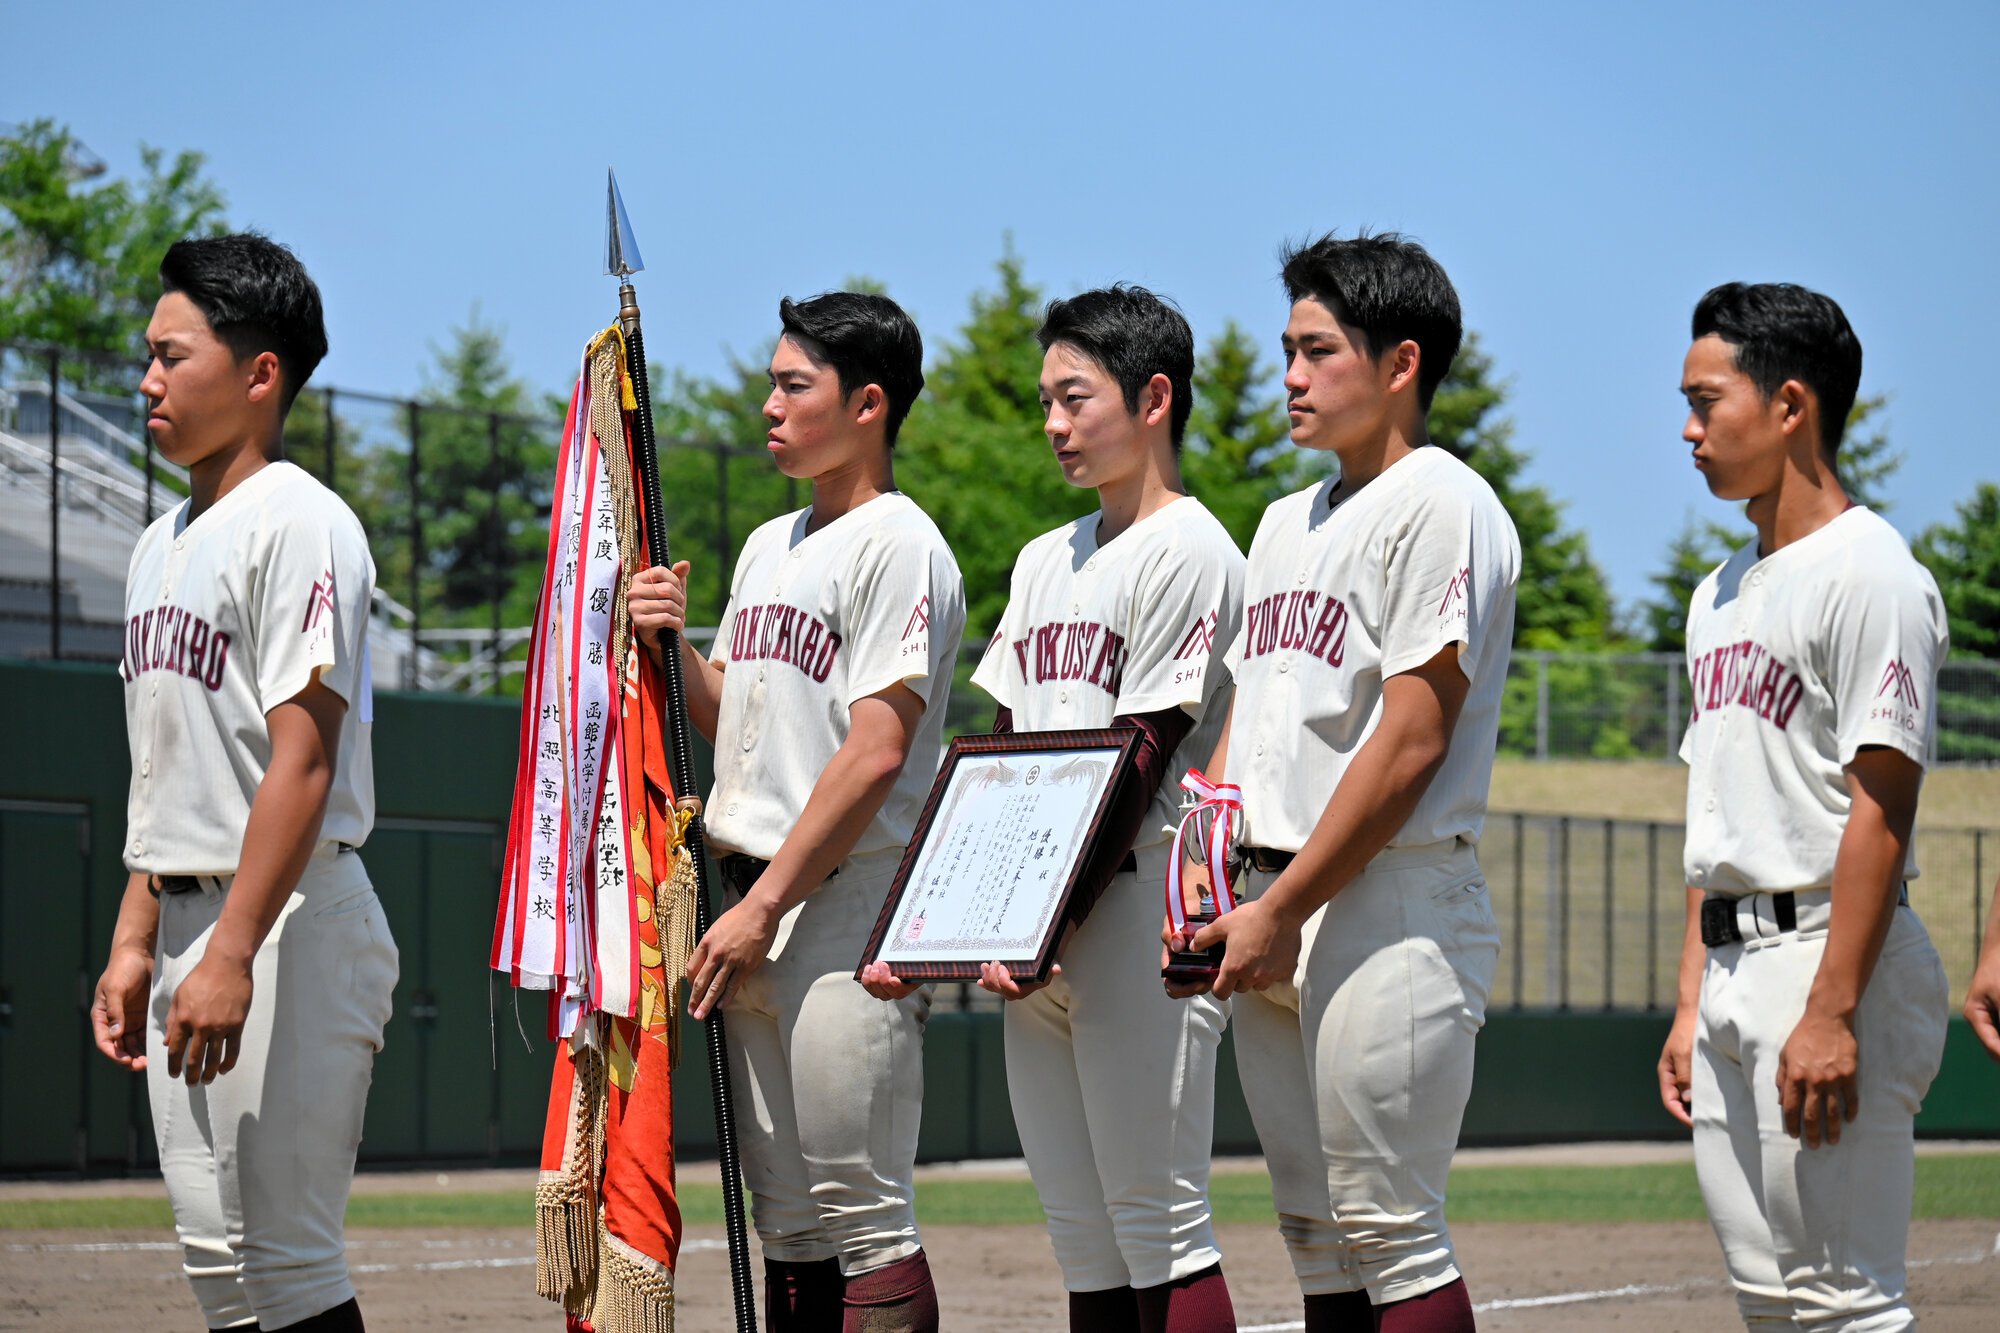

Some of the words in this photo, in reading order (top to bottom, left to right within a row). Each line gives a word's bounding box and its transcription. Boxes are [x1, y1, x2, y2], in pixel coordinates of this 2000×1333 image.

[533, 704, 562, 921] 北照高等学校
[1032, 827, 1052, 860] 優勝
